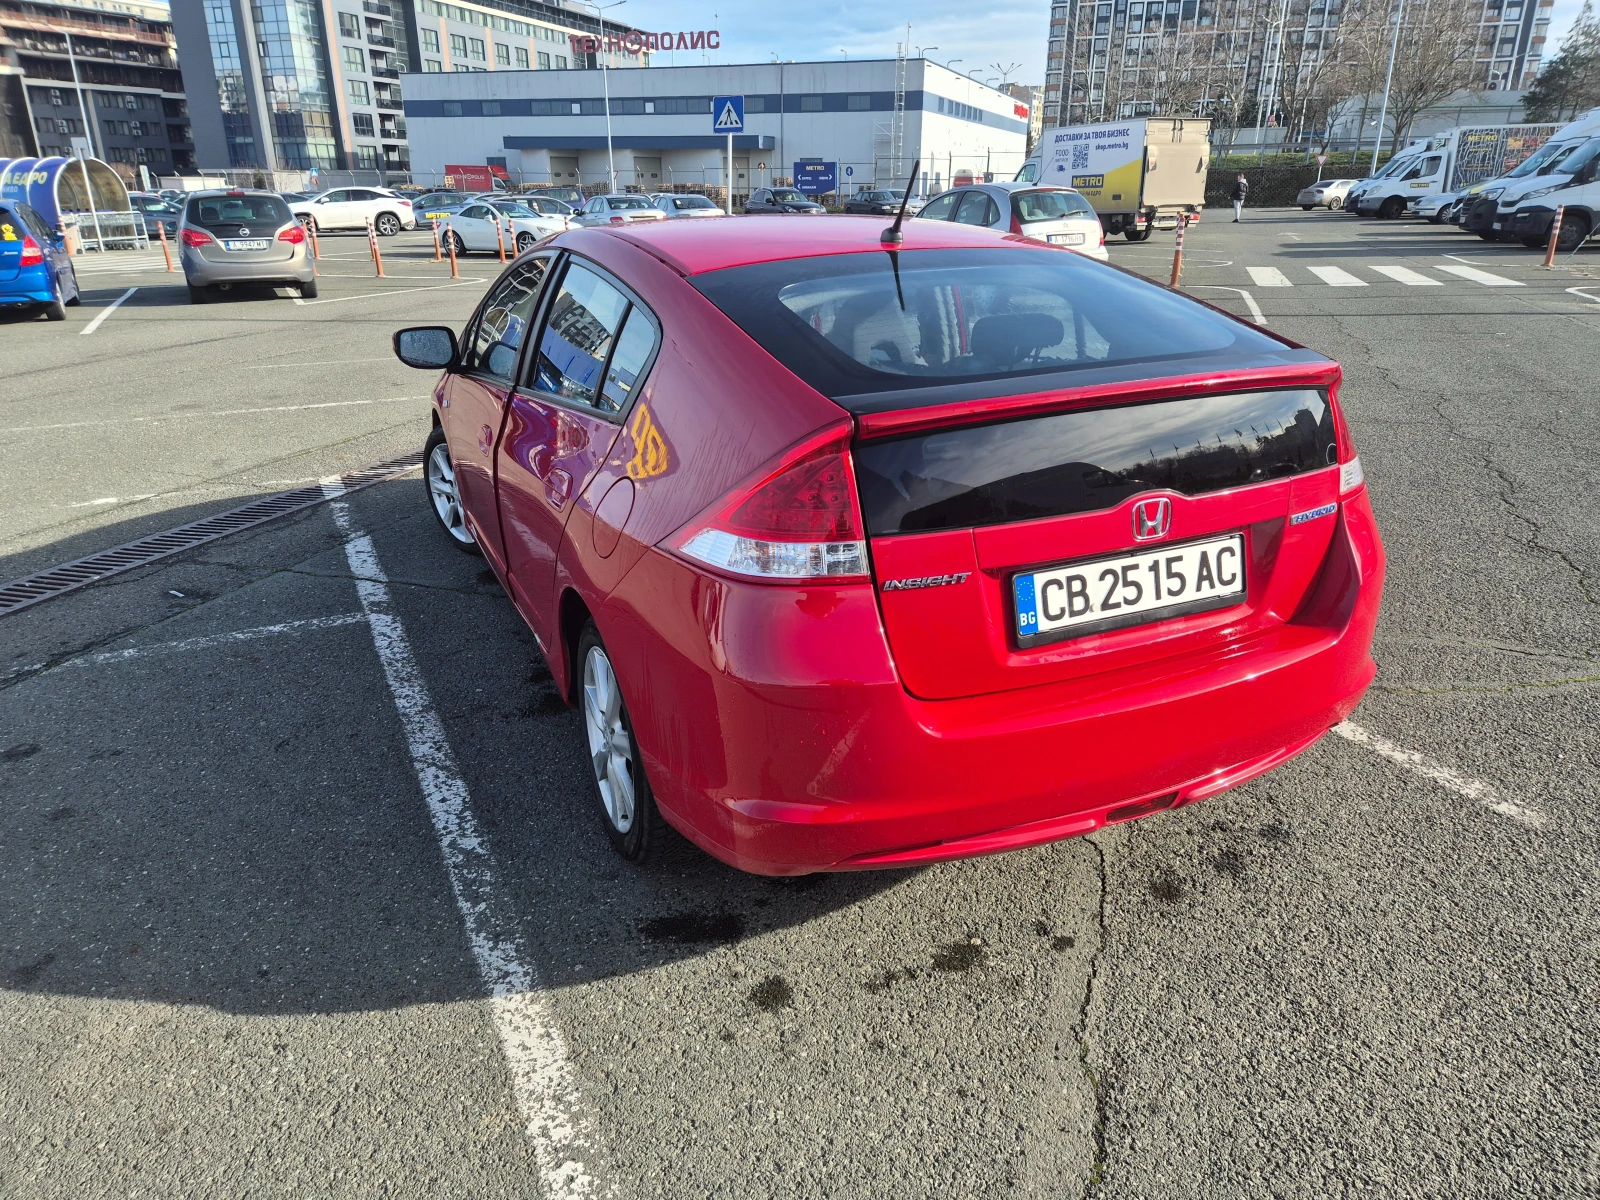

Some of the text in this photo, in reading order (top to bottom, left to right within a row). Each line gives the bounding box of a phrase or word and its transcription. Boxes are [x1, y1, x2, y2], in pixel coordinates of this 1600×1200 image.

[568, 30, 720, 54] ТЕХНОПОЛИС
[1054, 128, 1130, 144] ДОСТАВКИ ЗА ТВОЯ БИЗНЕС
[1095, 141, 1129, 151] shop.metro.bg
[1073, 176, 1103, 187] METRO
[1295, 504, 1336, 523] HYBRID
[1195, 546, 1237, 592] AC
[883, 571, 973, 591] INSIGHT
[1019, 612, 1036, 627] BG
